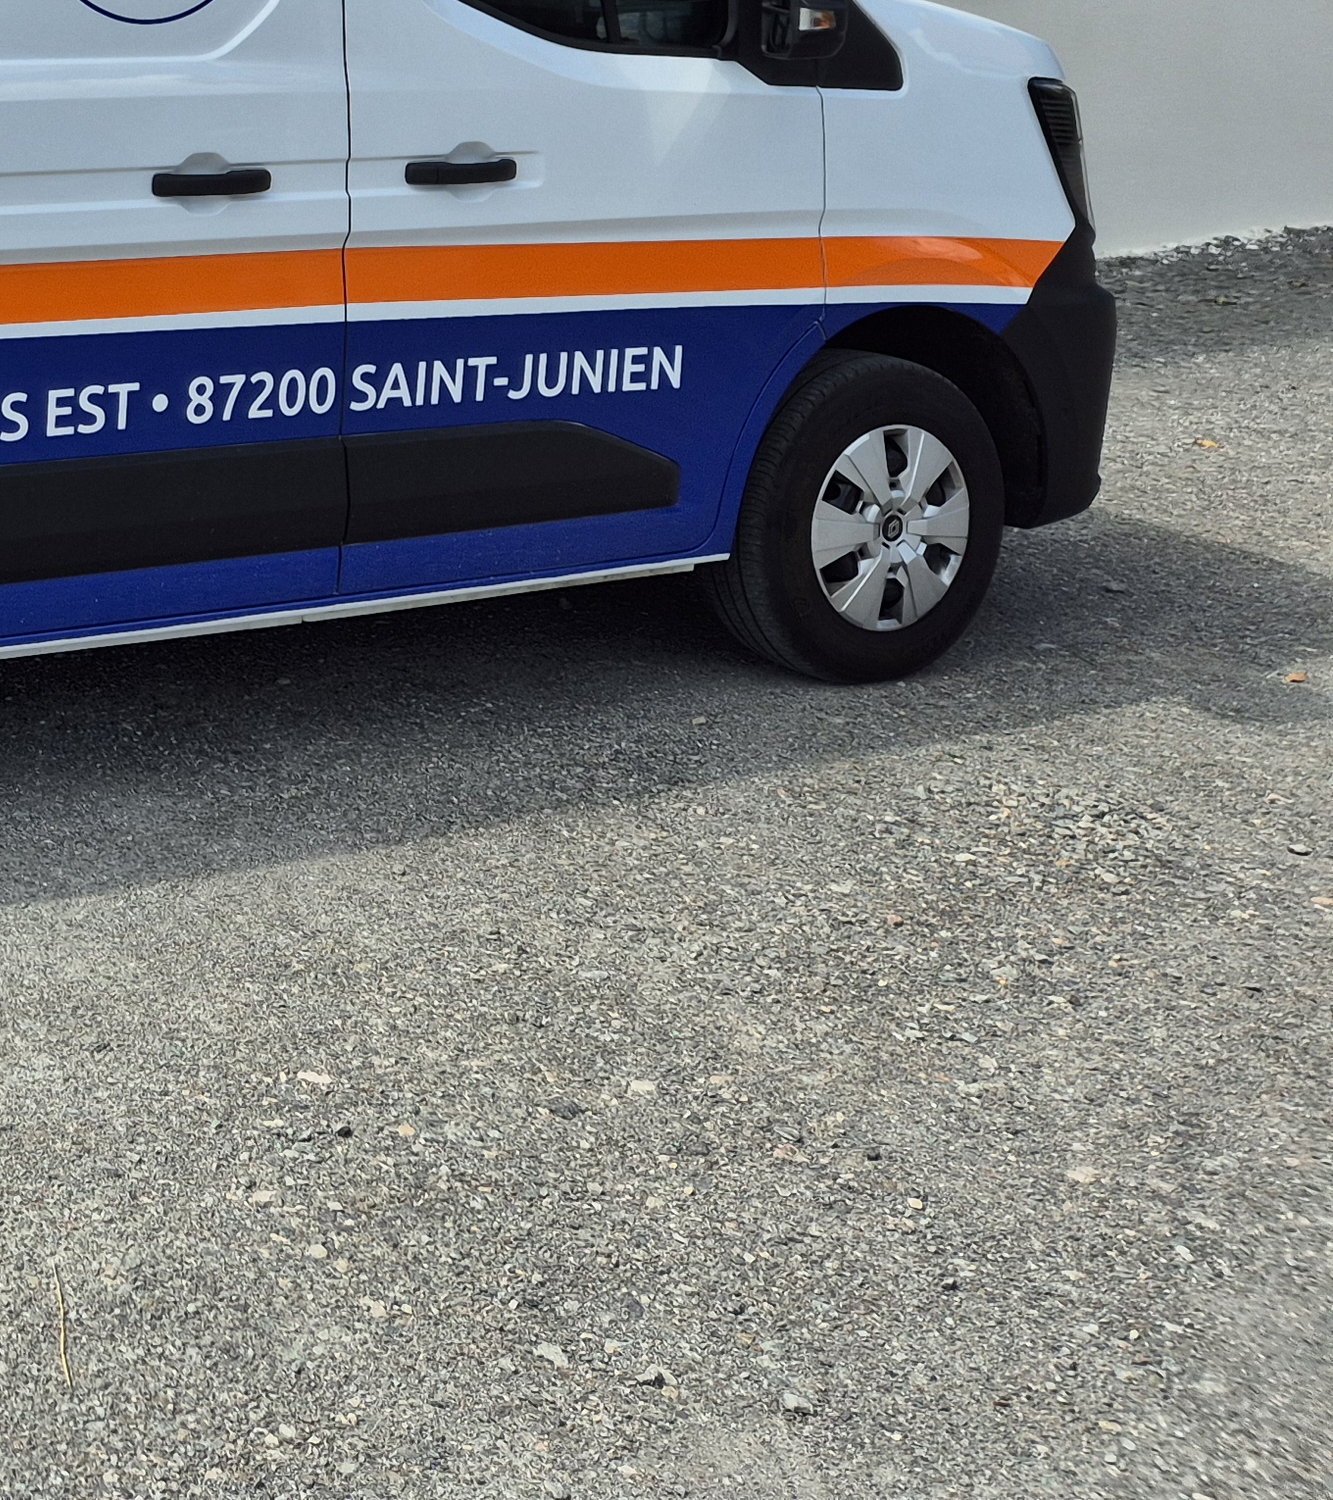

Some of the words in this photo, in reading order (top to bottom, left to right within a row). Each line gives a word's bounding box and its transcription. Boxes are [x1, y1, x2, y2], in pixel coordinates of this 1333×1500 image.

[45, 381, 141, 438] EST
[185, 366, 337, 425] 87200
[348, 343, 684, 413] SAINT-JUNIEN
